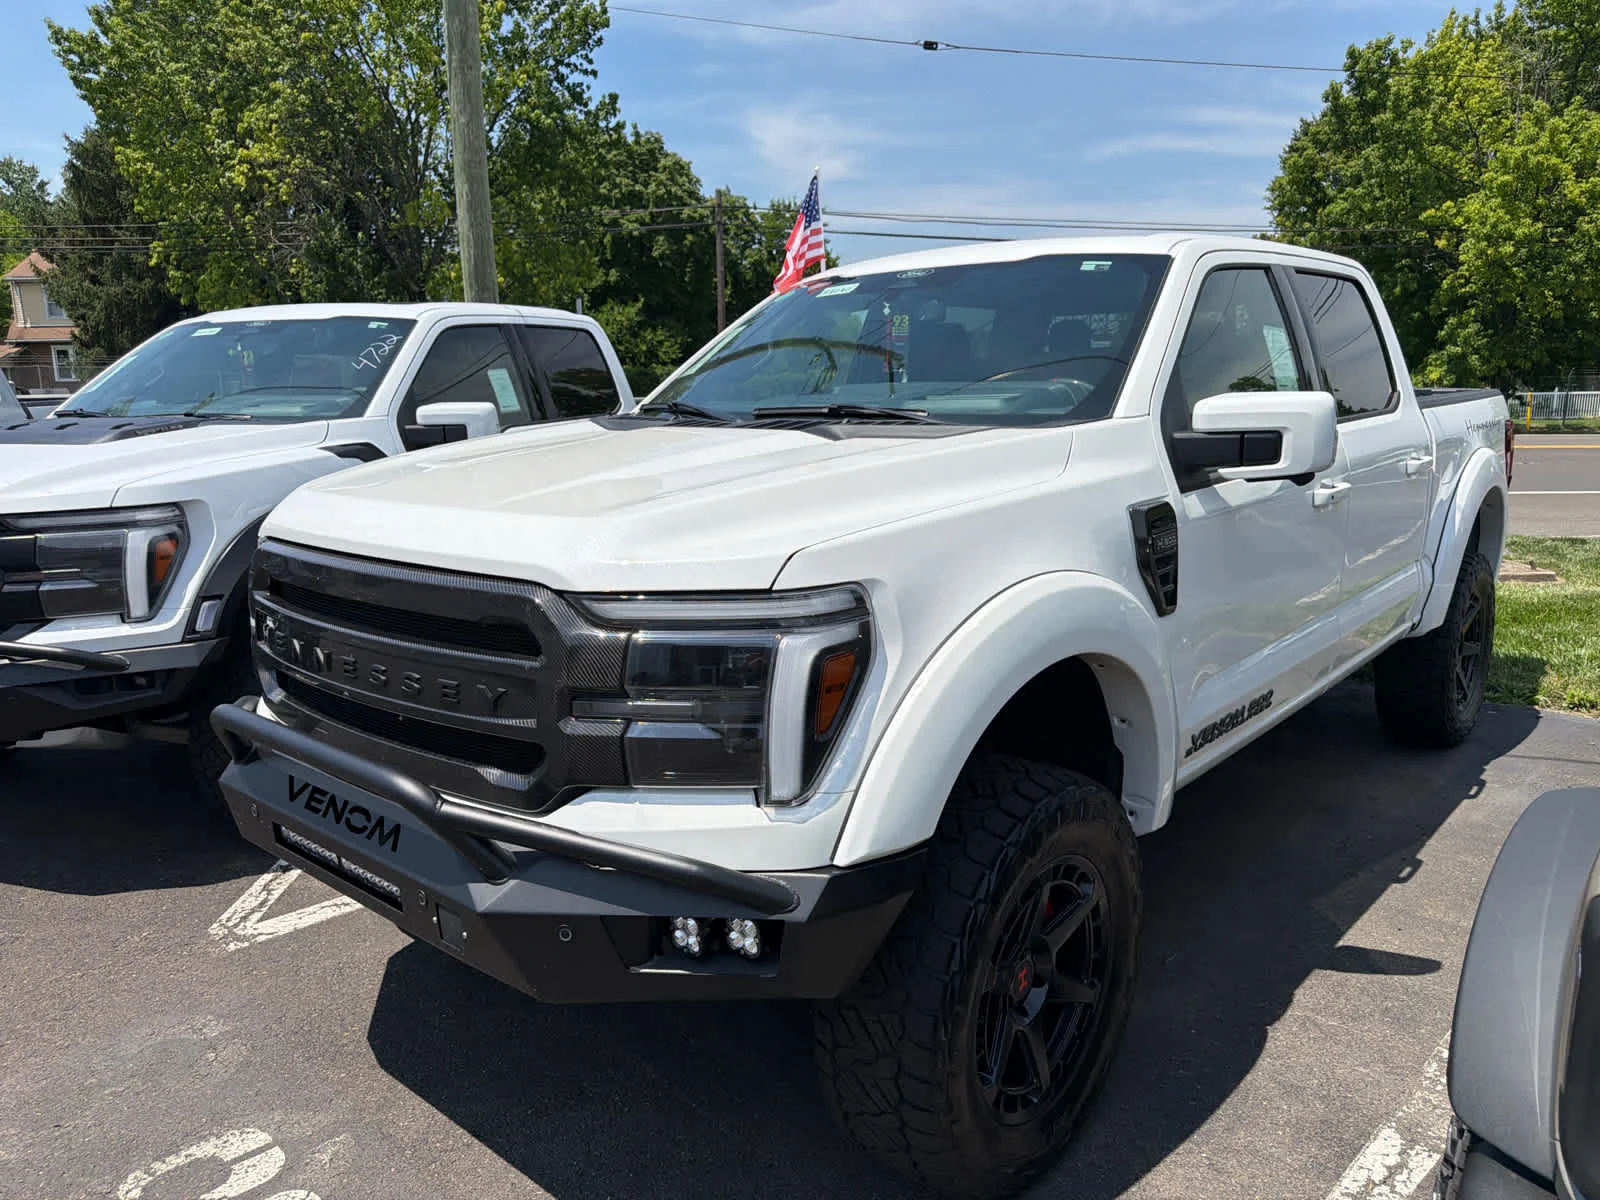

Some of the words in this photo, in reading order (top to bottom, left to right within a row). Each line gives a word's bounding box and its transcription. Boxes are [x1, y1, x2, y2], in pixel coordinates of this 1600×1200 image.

[893, 314, 909, 328] 93
[352, 334, 403, 369] 4722
[287, 774, 401, 853] VENOM
